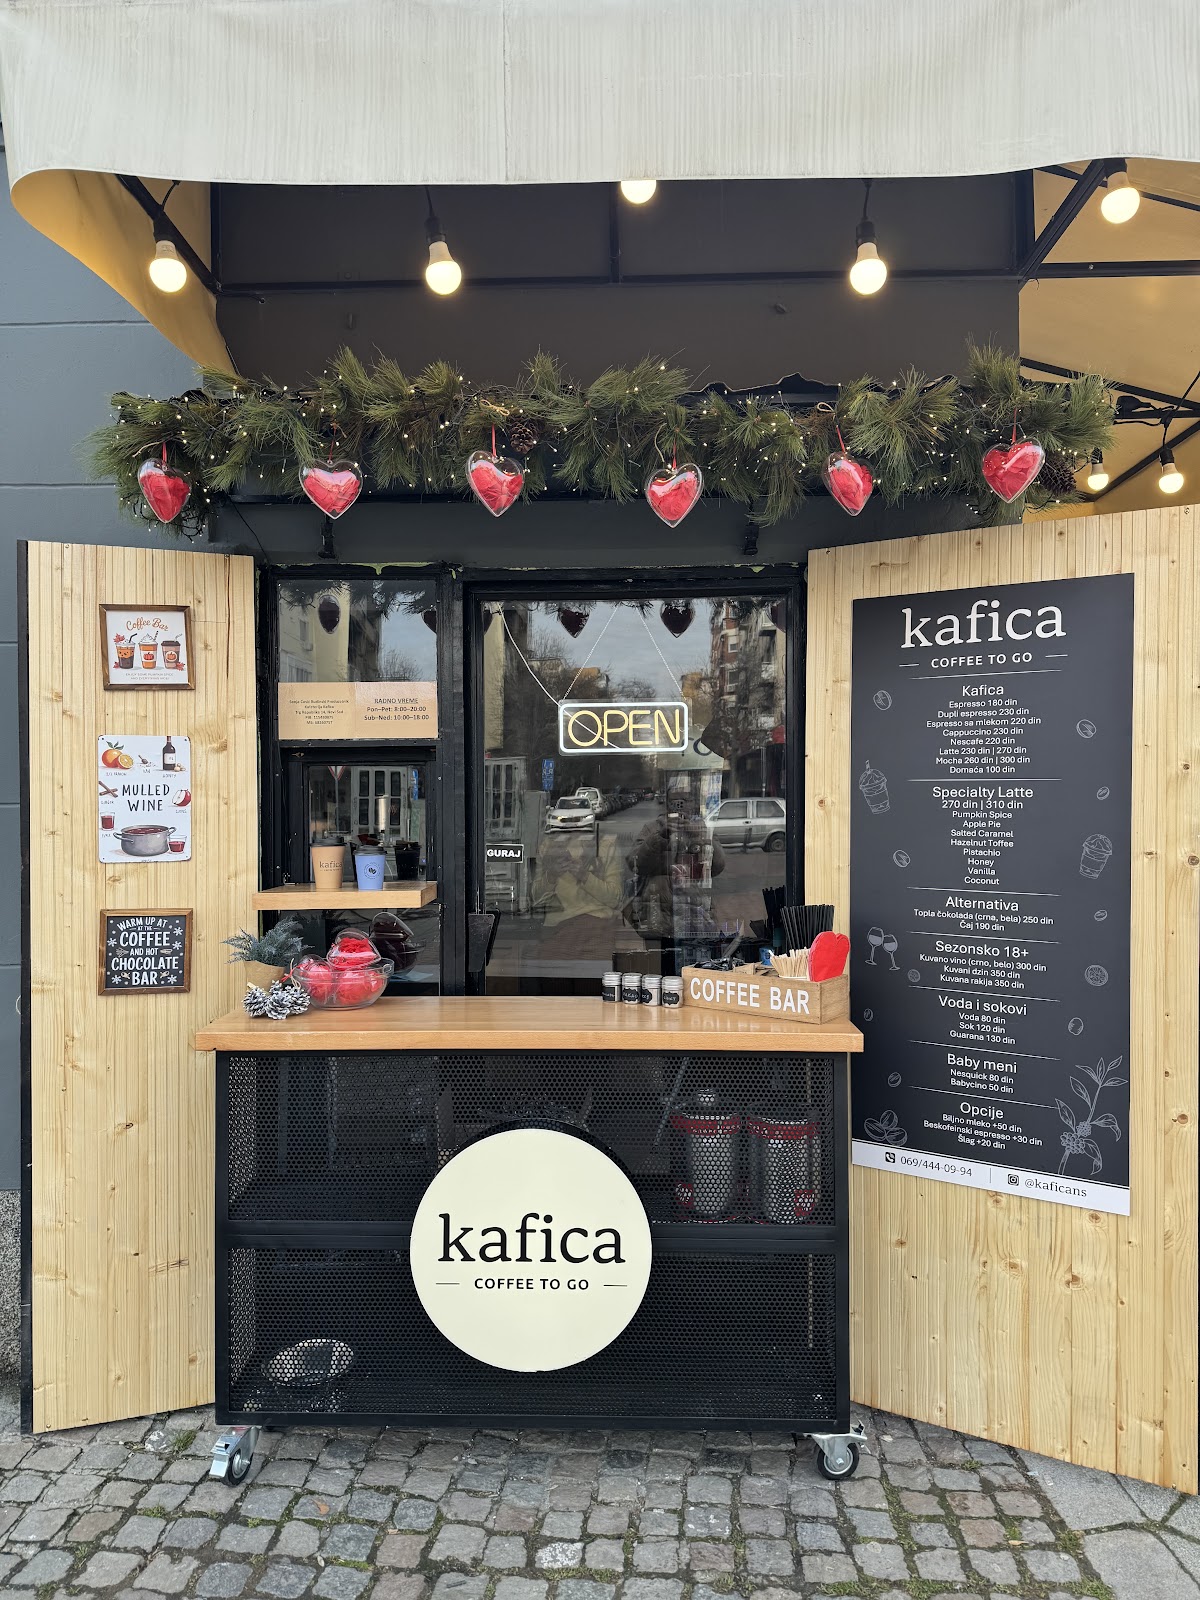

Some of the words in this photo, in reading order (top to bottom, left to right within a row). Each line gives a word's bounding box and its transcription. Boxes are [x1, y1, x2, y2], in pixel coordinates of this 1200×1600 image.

[126, 617, 151, 630] Coffee
[152, 618, 168, 631] Bar
[900, 599, 1066, 648] kafica
[931, 656, 982, 668] COFFEE
[988, 654, 1006, 665] TO
[1012, 652, 1032, 663] GO
[962, 685, 1004, 696] Kafica
[949, 701, 985, 709] Espresso
[938, 710, 958, 719] Dupli
[568, 709, 680, 746] OPEN
[927, 720, 962, 728] Espresso
[943, 729, 991, 737] Cappuccino
[122, 784, 170, 796] MULLED
[933, 787, 995, 800] Specialty
[998, 787, 1033, 798] Latte
[127, 800, 162, 811] WINE
[942, 800, 960, 808] 270
[962, 800, 978, 808] din
[986, 800, 1004, 808] 310
[1007, 800, 1023, 809] din
[952, 811, 987, 820] Pumpkin
[486, 849, 520, 858] GURAJ
[968, 858, 994, 866] Honey
[946, 897, 1018, 911] Alternativa
[914, 909, 935, 918] Topla
[937, 910, 973, 919] čokolada
[975, 913, 998, 922] (crna,
[1001, 914, 1021, 923] bela)
[117, 917, 143, 931] WARM
[157, 919, 168, 928] AT
[960, 920, 973, 930] Čaj
[120, 932, 170, 946] COFFEE
[936, 941, 1000, 956] Sezonsko
[1004, 946, 1028, 957] 18+
[112, 957, 178, 970] CHOCOLATE
[920, 954, 948, 963] Kuvano
[968, 958, 991, 968] (crno,
[994, 961, 1014, 969] belo)
[944, 965, 970, 974] Kuvani
[132, 972, 157, 985] BAR
[940, 974, 969, 983] Kuvana
[971, 977, 992, 986] rakija
[690, 978, 760, 1008] COFFEE
[770, 987, 810, 1014] BAR
[939, 995, 972, 1010] Voda
[976, 999, 979, 1010] i
[984, 1002, 1026, 1015] sokovi
[959, 1012, 979, 1021] Voda
[960, 1022, 974, 1030] Sok
[950, 1030, 984, 1040] Guarana
[947, 1054, 980, 1069] Baby
[984, 1060, 1017, 1073] meni
[951, 1069, 987, 1080] Nesquick
[1001, 1076, 1014, 1084] din
[951, 1078, 987, 1090] Babycino
[960, 1102, 1003, 1118] Opcije
[943, 1114, 964, 1124] Biljno
[966, 1118, 990, 1128] mleko
[992, 1122, 1007, 1131] +50
[1009, 1124, 1022, 1133] din
[924, 1120, 972, 1134] Beskofeinski
[974, 1128, 1010, 1141] espresso
[1013, 1134, 1028, 1142] +30
[1029, 1137, 1042, 1146] din
[958, 1134, 975, 1146] Šlag
[977, 1138, 991, 1147] +20
[993, 1140, 1005, 1149] din
[901, 1156, 972, 1176] 069/444-09-94
[1025, 1178, 1087, 1197] @kaficans
[438, 1212, 626, 1263] kafica
[474, 1278, 534, 1289] COFFEE
[540, 1279, 560, 1290] TO
[567, 1280, 589, 1290] GO
